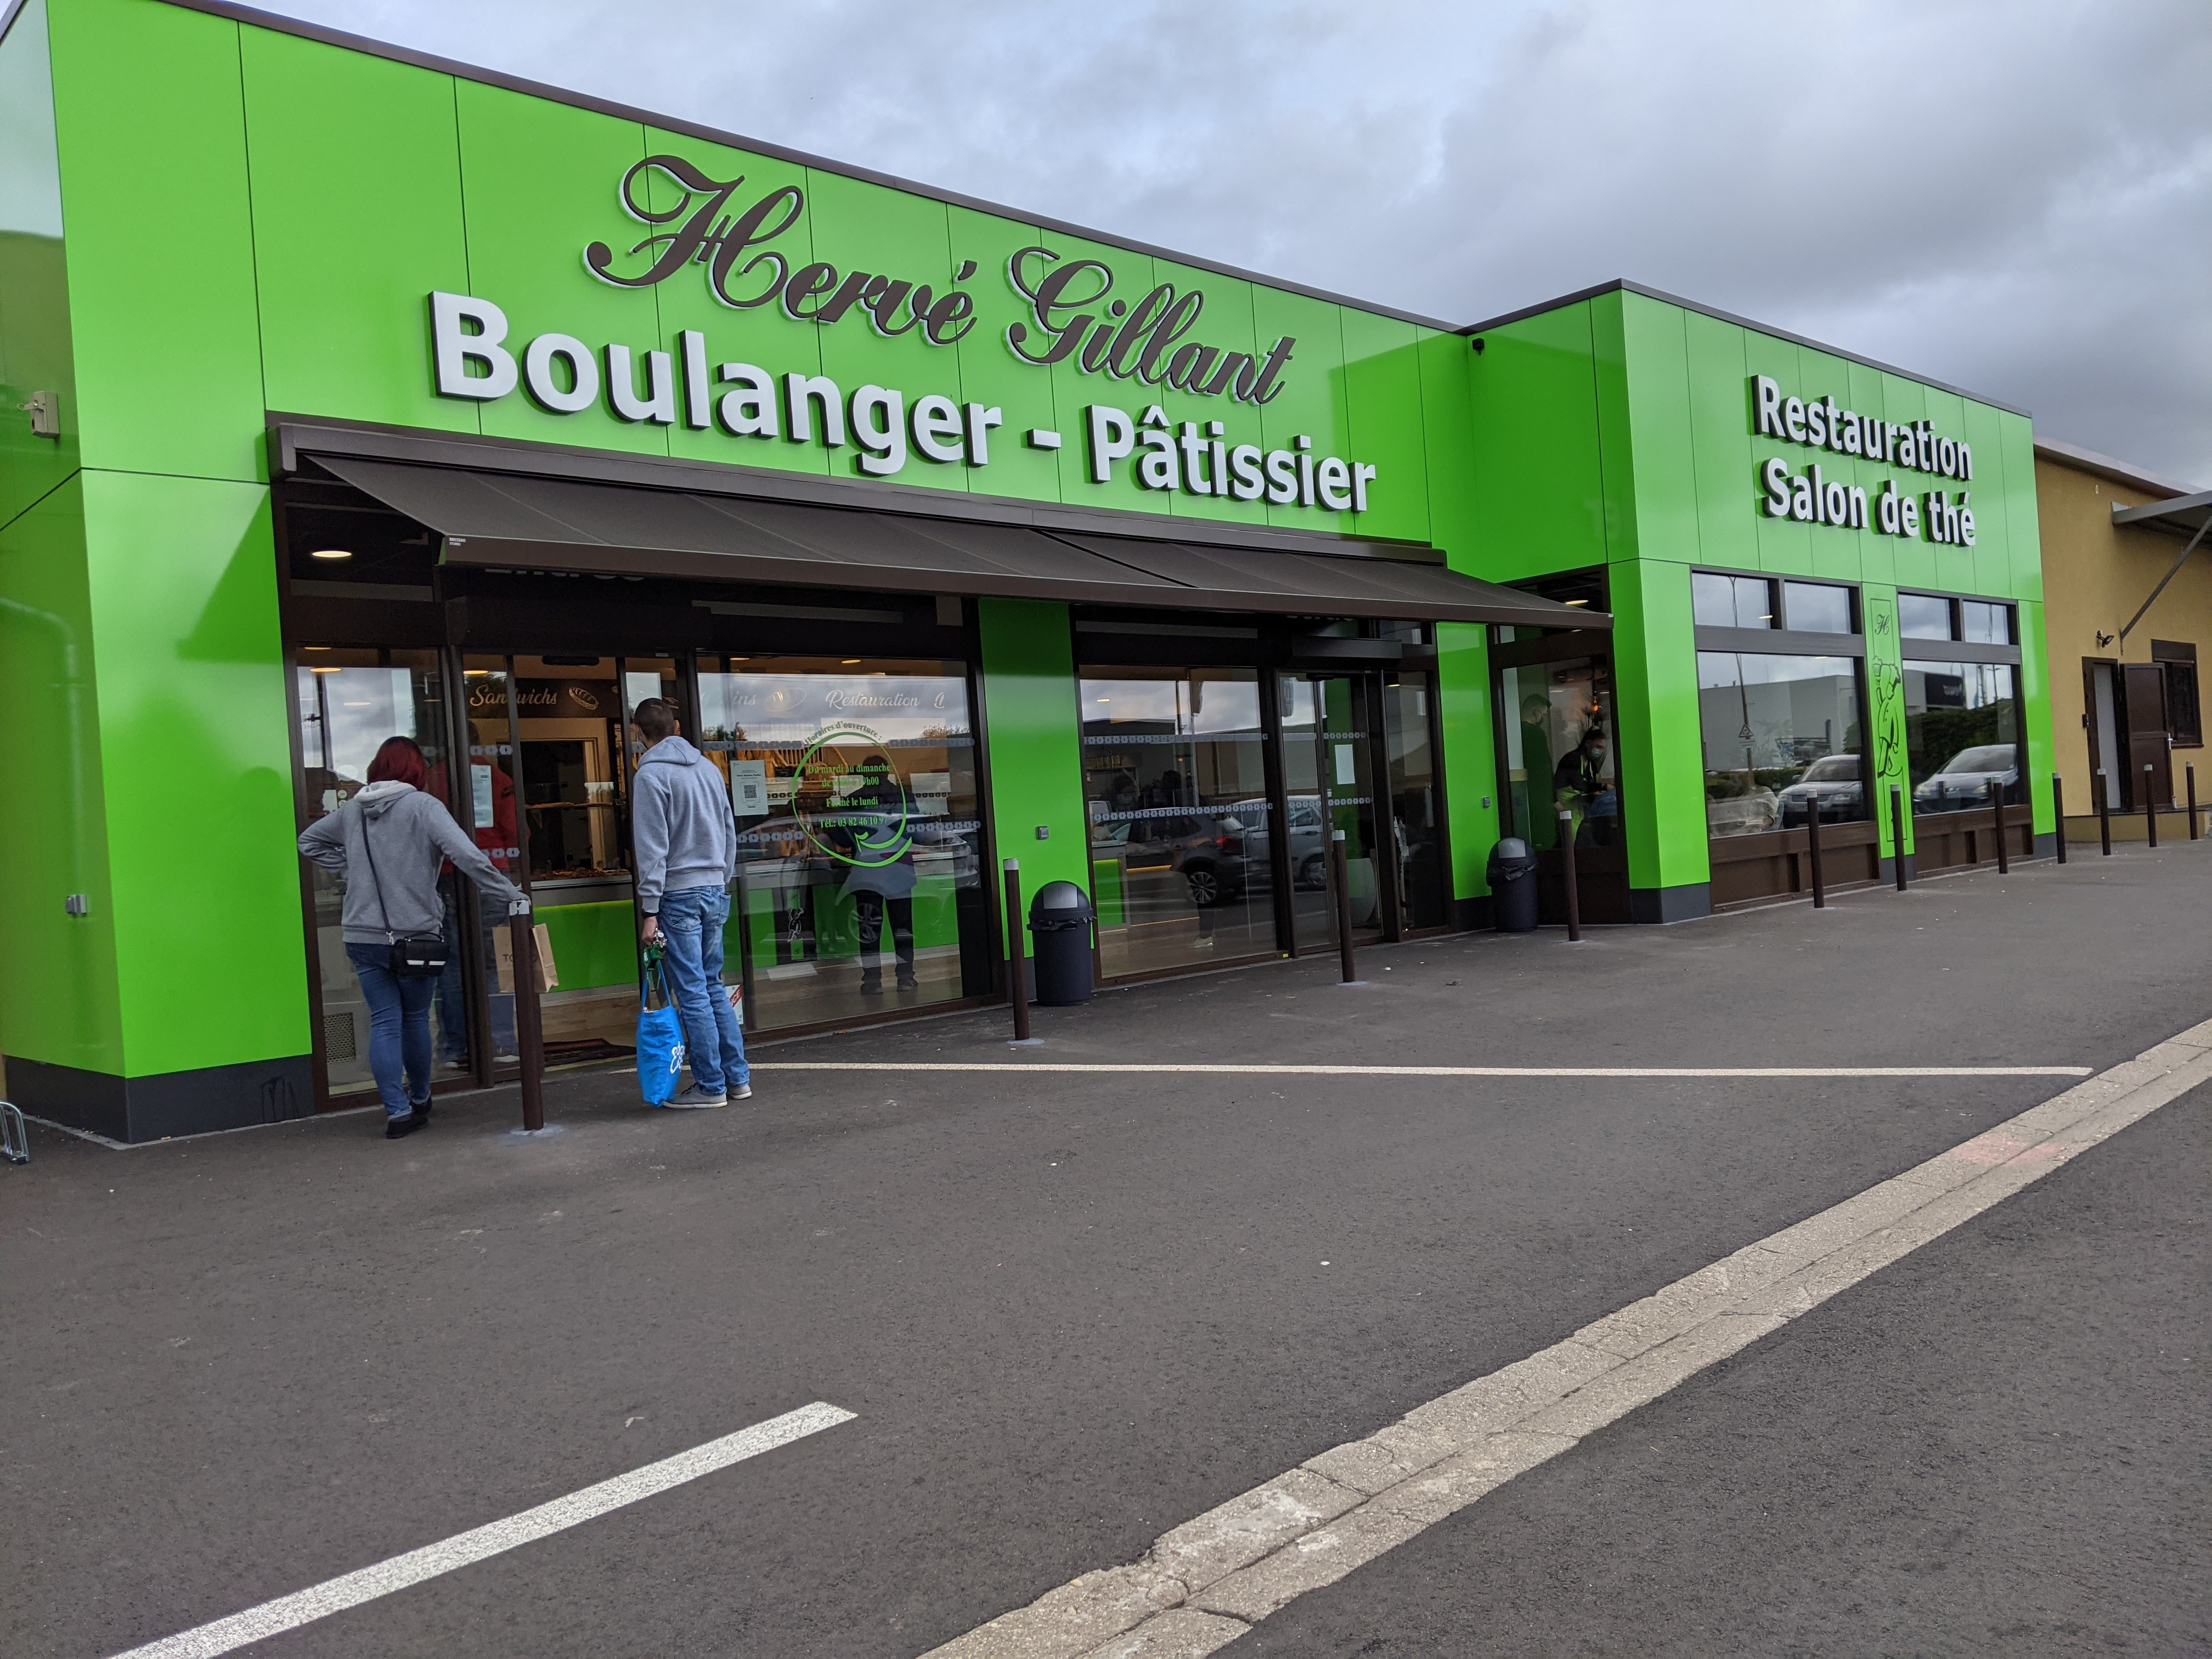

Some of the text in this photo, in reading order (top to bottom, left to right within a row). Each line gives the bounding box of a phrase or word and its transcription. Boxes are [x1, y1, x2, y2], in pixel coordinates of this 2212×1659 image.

[582, 154, 1296, 405] Hervé Gillant
[428, 290, 1002, 476] Boulanger
[1085, 404, 1376, 512] Pâtissier
[1751, 374, 1973, 481] Restauration
[1760, 457, 1976, 547] Salon de thé
[470, 685, 557, 706] Sanwichs
[825, 690, 919, 709] Restauration
[804, 724, 834, 746] Horaires
[836, 720, 878, 737] d'ouverture
[808, 765, 819, 774] Du
[821, 764, 844, 773] mardi
[856, 763, 890, 773] dimanche
[822, 778, 831, 787] de
[851, 797, 859, 806] le
[859, 796, 879, 806] lundi
[838, 817, 846, 827] 03
[848, 817, 856, 826] 82
[859, 817, 867, 826] 46
[870, 816, 878, 825] 10
